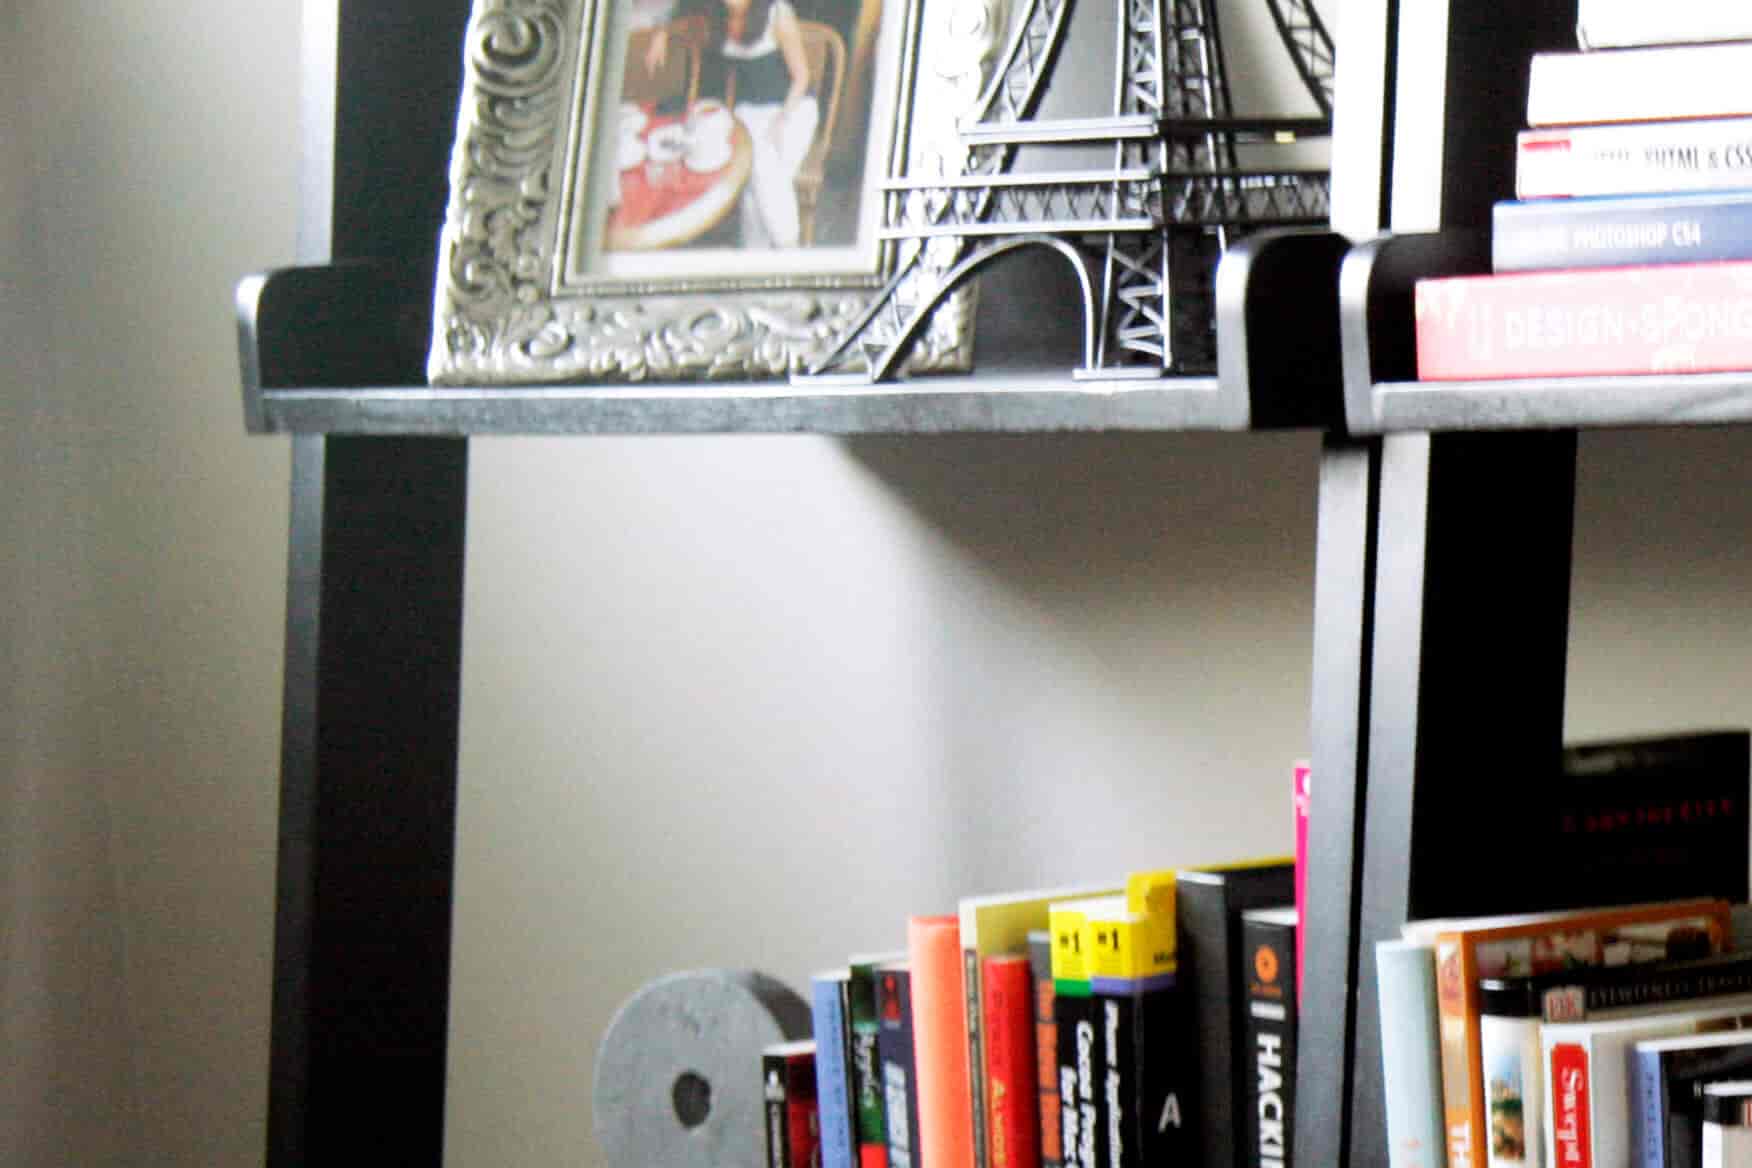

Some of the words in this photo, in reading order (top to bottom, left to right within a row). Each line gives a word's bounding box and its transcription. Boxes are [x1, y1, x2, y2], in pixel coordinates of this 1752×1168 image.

[1060, 1066, 1076, 1102] for
[1075, 1020, 1097, 1099] Cocoa
[1061, 1106, 1079, 1157] Mac
[1557, 1067, 1584, 1160] Swept
